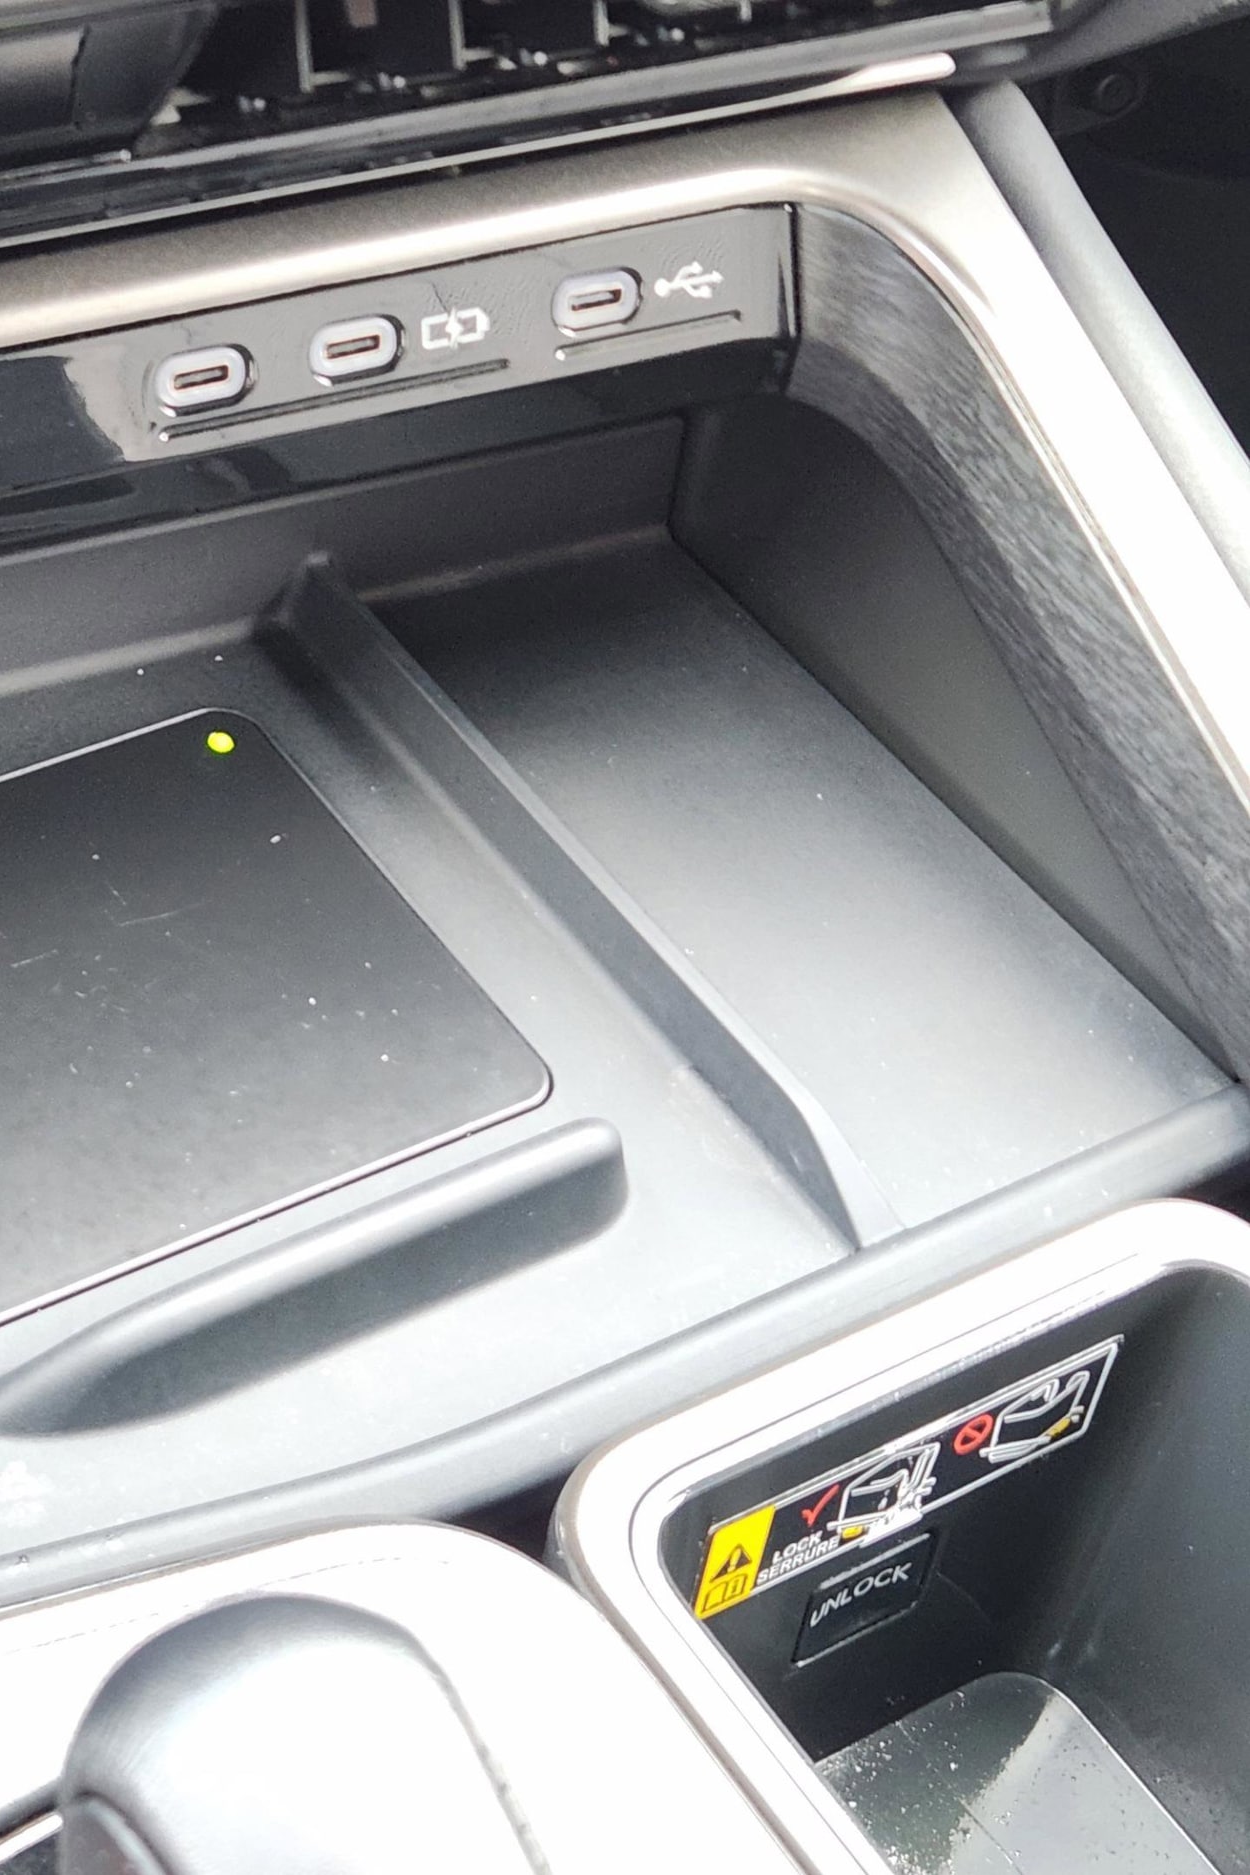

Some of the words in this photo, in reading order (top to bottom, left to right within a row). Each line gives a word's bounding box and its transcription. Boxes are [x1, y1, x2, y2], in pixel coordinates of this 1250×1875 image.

[755, 1535, 840, 1586] SERRURE
[772, 1530, 823, 1564] LOCK
[810, 1562, 913, 1628] UNLOCK
